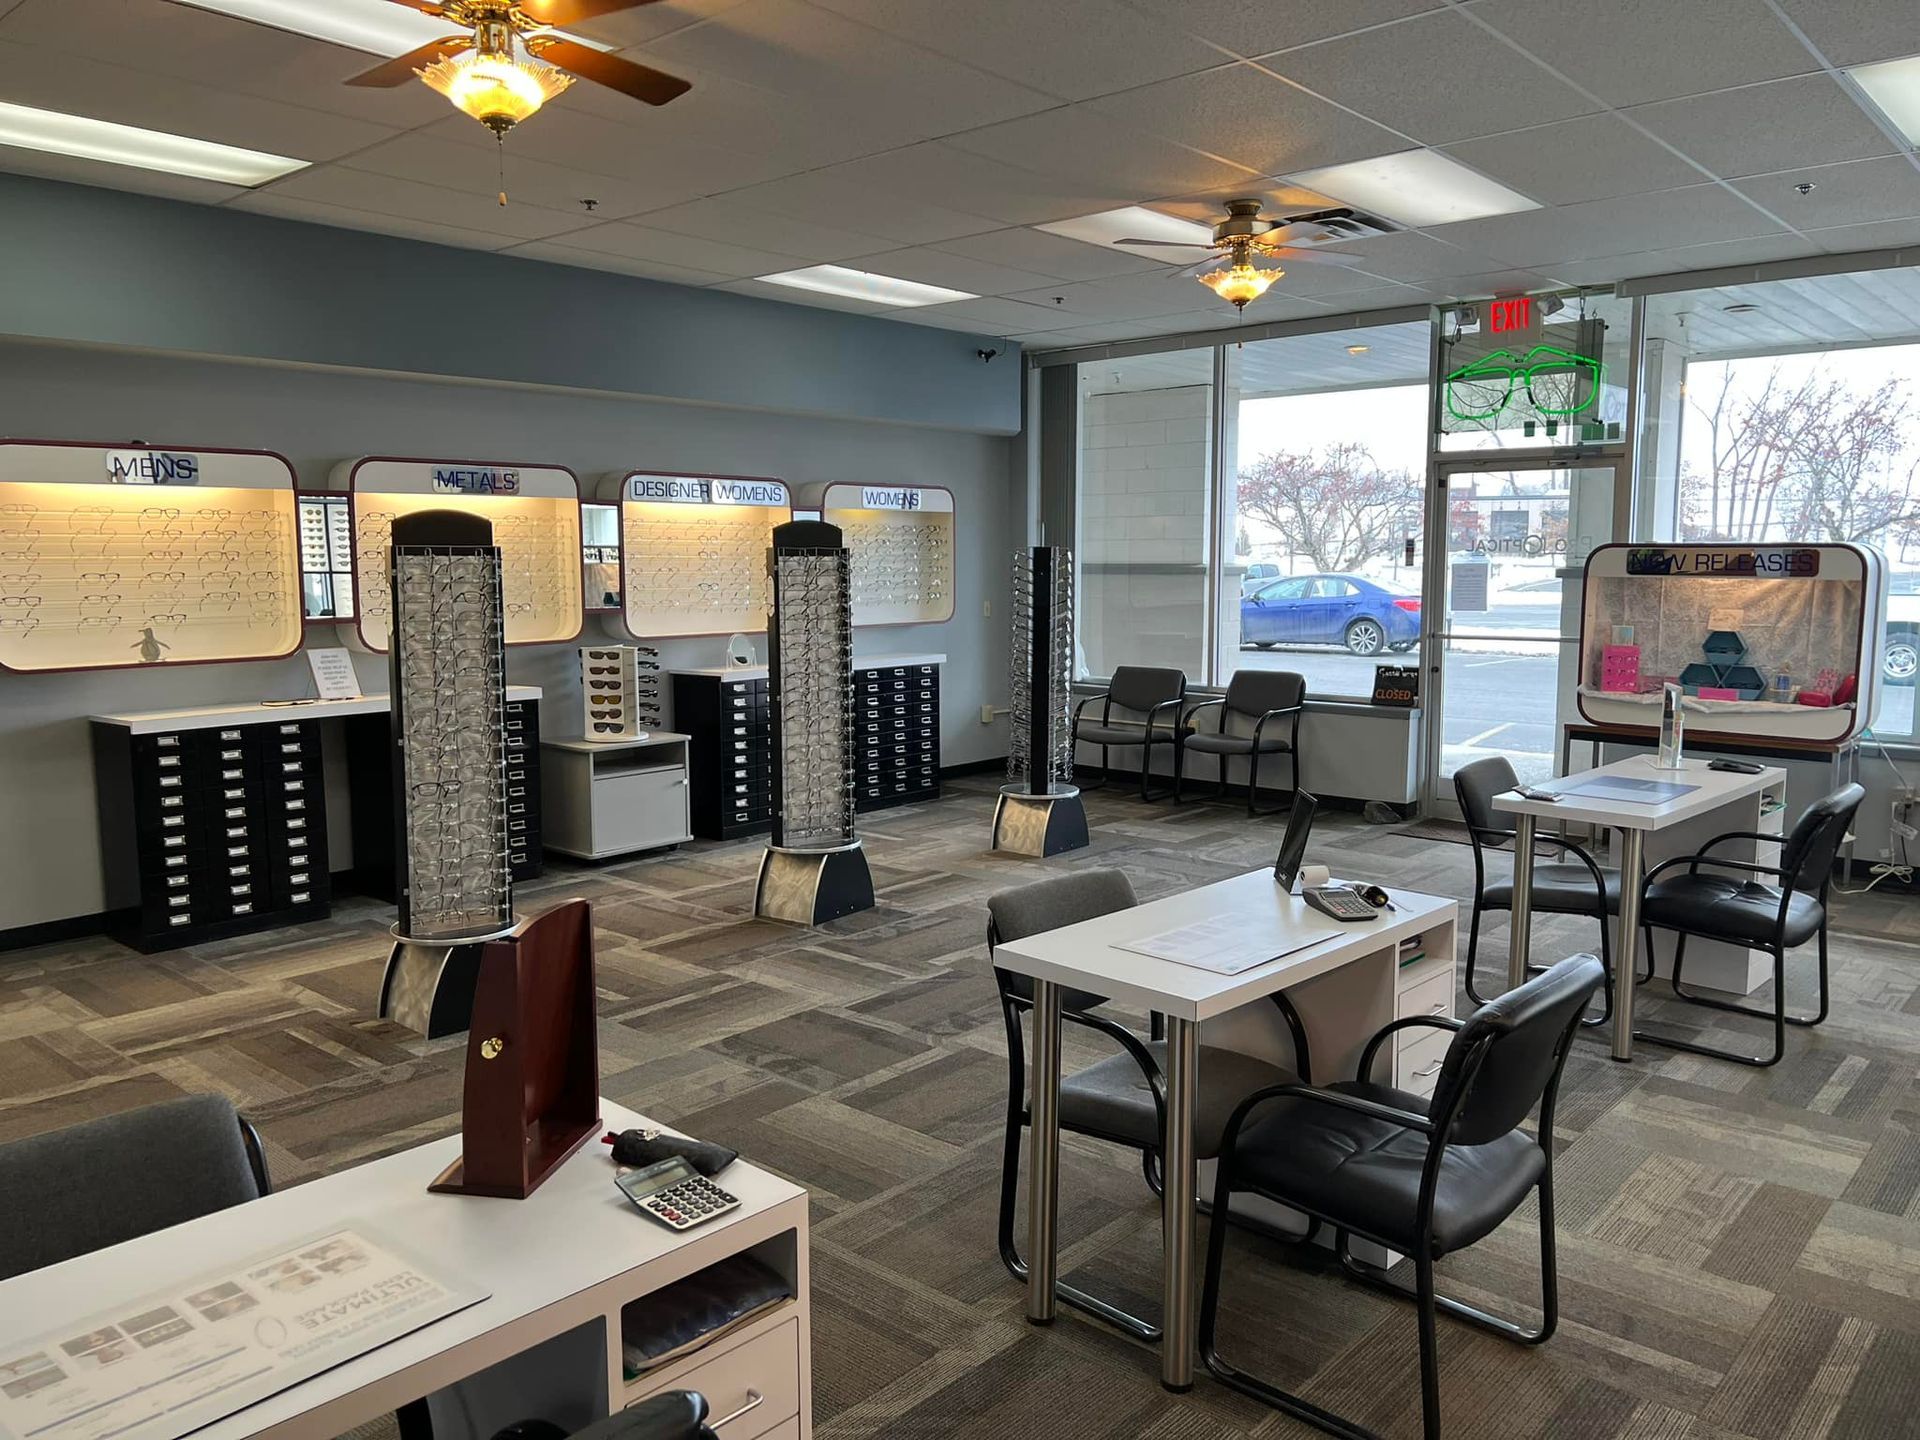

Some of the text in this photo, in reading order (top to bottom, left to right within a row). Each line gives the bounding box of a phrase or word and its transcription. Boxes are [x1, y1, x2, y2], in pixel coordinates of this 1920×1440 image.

[1490, 298, 1532, 333] EXIT
[113, 456, 192, 479] MENS
[436, 470, 516, 490] METALS
[634, 480, 782, 502] DESIGNER WOMENS
[865, 491, 919, 507] WOMENS
[1695, 553, 1813, 572] RELEASES
[1375, 689, 1411, 700] CLOSED
[302, 1276, 424, 1330] ULTIMATE
